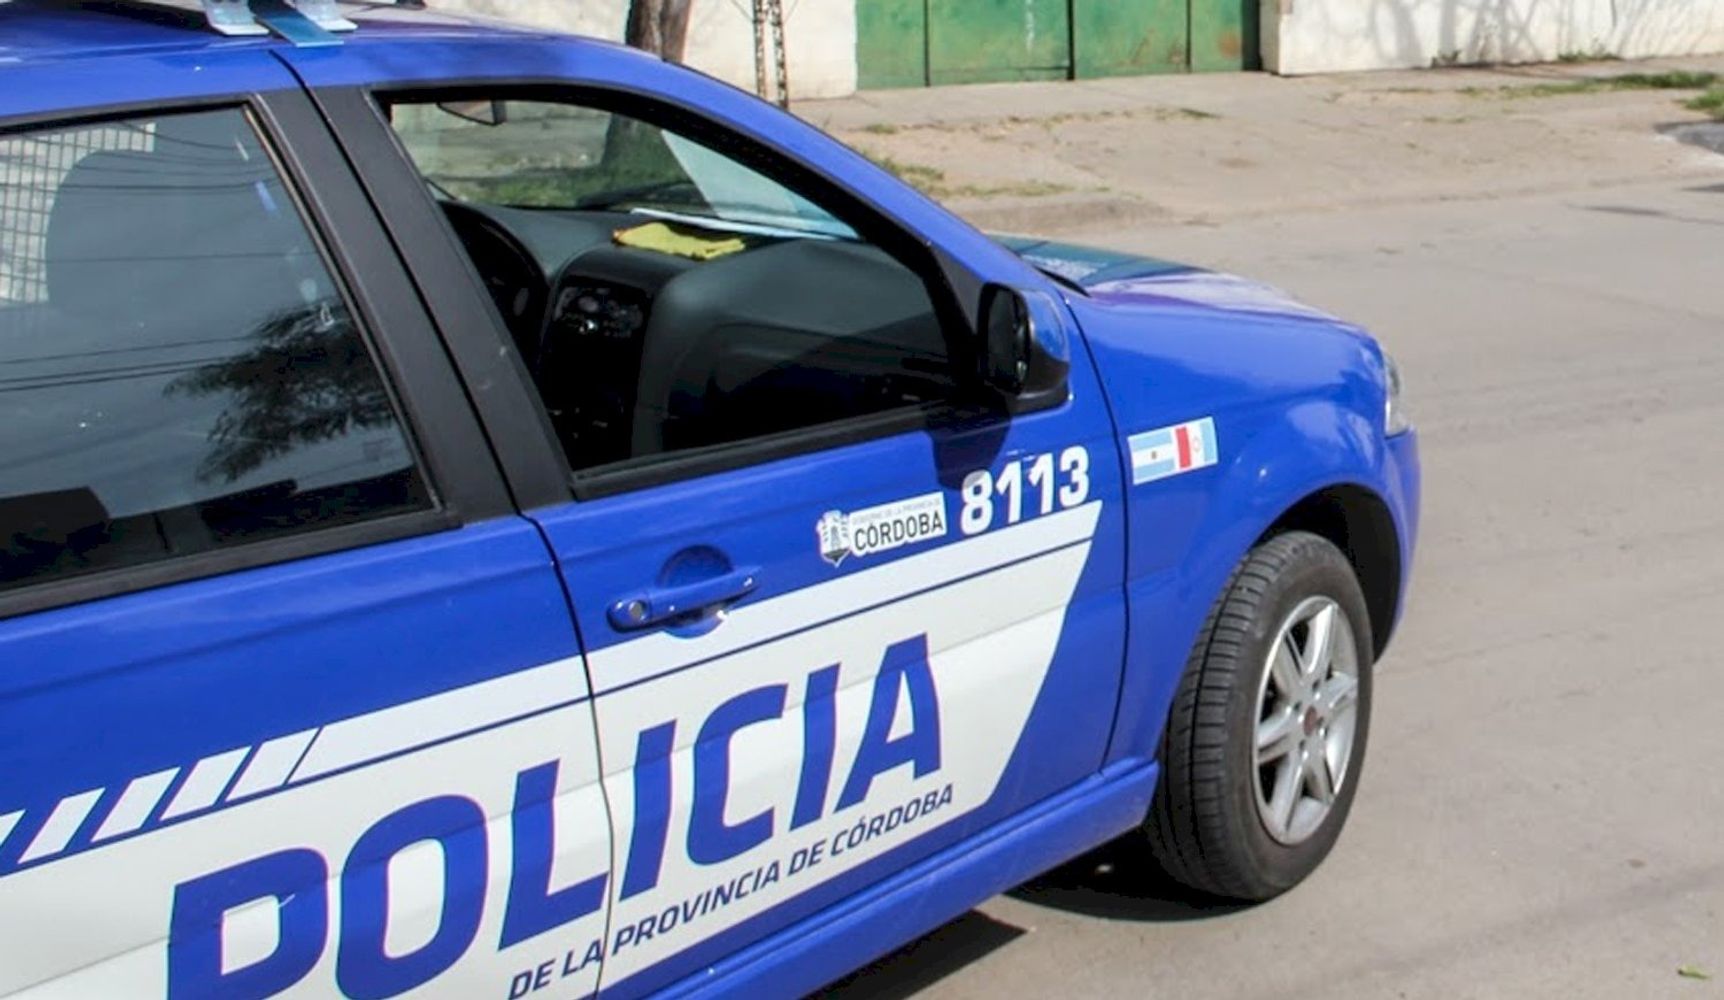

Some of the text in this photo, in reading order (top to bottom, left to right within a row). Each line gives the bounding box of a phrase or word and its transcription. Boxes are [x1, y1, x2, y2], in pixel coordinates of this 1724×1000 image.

[960, 445, 1090, 536] 8113
[166, 632, 942, 1000] POLICIA
[508, 783, 954, 1000] DE LA PROVINCIA DE CÓRDOBA
